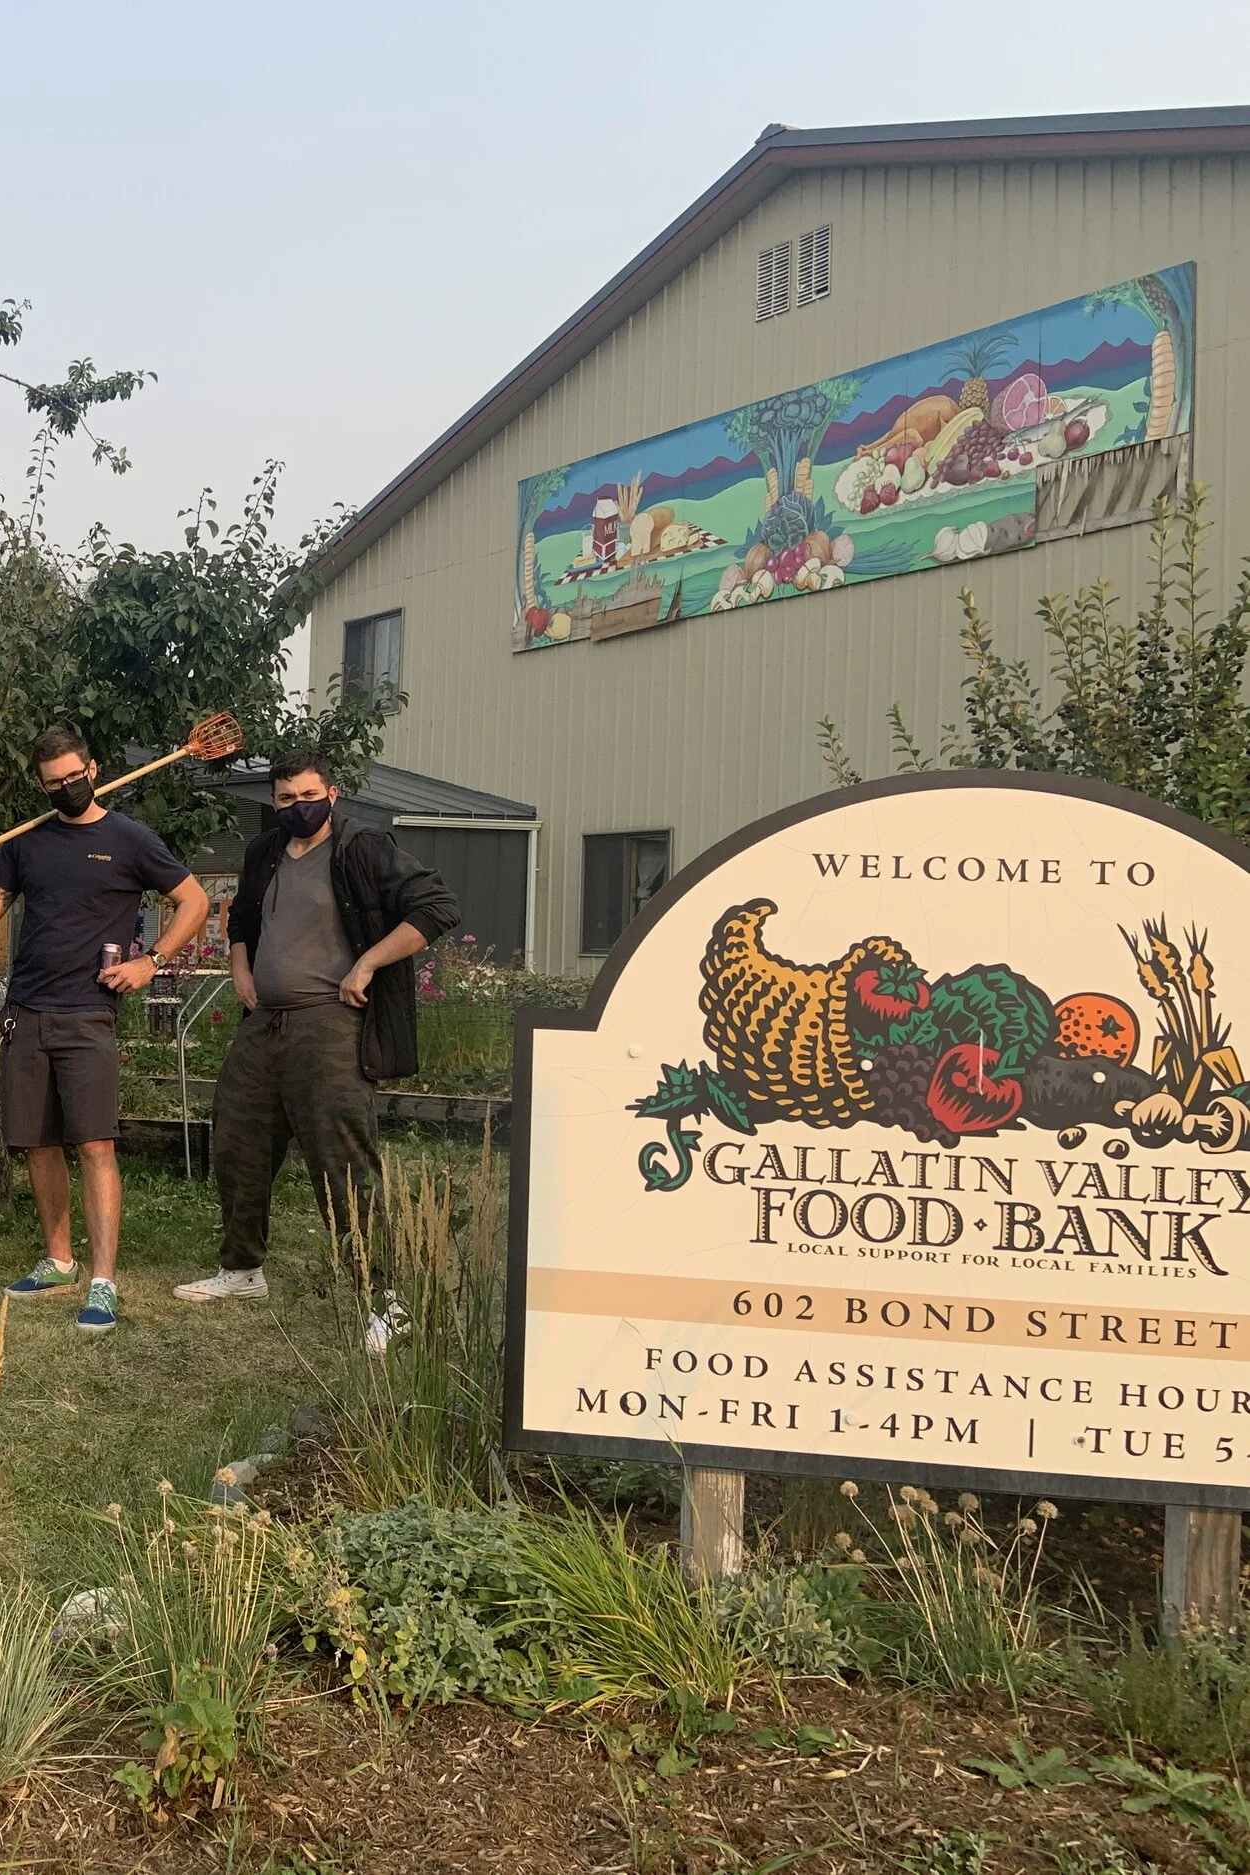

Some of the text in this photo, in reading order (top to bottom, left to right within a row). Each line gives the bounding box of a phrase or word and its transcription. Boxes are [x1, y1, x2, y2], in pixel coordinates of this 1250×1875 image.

[811, 853, 1156, 887] WELCOME TO
[702, 1142, 1250, 1214] GALLATIN VALLEY
[749, 1186, 1229, 1276] FOOD BANK
[786, 1242, 1197, 1279] LOCAL SUPPORT FOR LOCAL FAMILIES
[732, 1290, 1239, 1349] 602 BOND STREET
[645, 1347, 1250, 1414] FOOD ASSISTANCE HOUR
[576, 1387, 801, 1430] MON-FRI
[830, 1408, 980, 1445] 1-4PM
[1084, 1425, 1186, 1460] TUE
